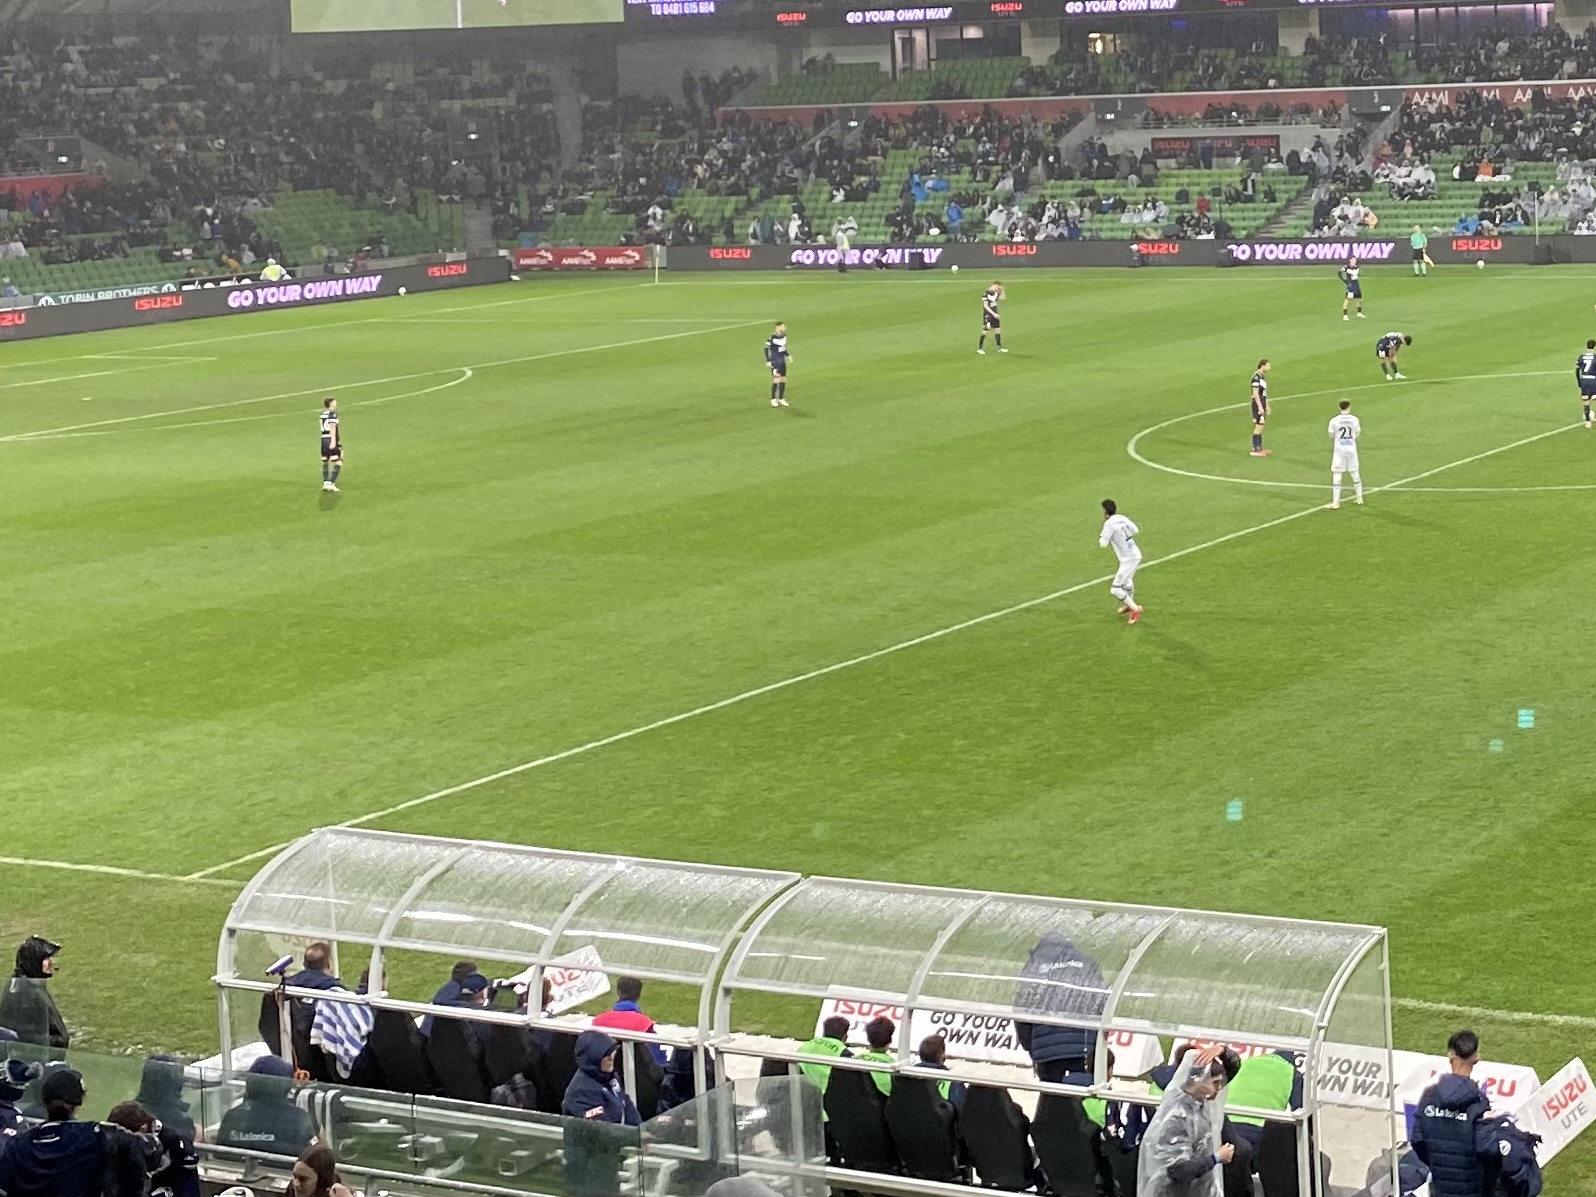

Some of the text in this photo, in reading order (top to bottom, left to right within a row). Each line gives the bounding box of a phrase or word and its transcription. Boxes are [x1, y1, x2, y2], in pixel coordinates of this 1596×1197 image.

[650, 3, 662, 15] TO
[990, 3, 1023, 12] ISUZU
[1065, 1, 1085, 13] GO
[1085, 0, 1117, 12] YOUR
[777, 12, 806, 23] ISUZU
[847, 6, 953, 24] GO YOUR OWN WAY
[992, 244, 1037, 256] ISUZU
[1138, 243, 1179, 254] SUZU
[1253, 244, 1302, 260] YOUR
[1304, 244, 1354, 260] OWN
[1355, 243, 1396, 259] WAY
[1452, 239, 1503, 251] ISUZU
[710, 248, 752, 260] ISUZU
[791, 249, 815, 264] GO
[428, 264, 468, 278] ISUZU
[228, 274, 382, 308] GO YOUR OWN WAY
[134, 295, 183, 311] ISUZU
[1583, 359, 1593, 373] 7
[930, 1010, 1011, 1032] GO YOUR
[984, 1031, 1022, 1051] WA
[1326, 1056, 1382, 1079] YOUR
[1542, 1074, 1587, 1122] ISUZU
[1561, 1101, 1588, 1129] UTE
